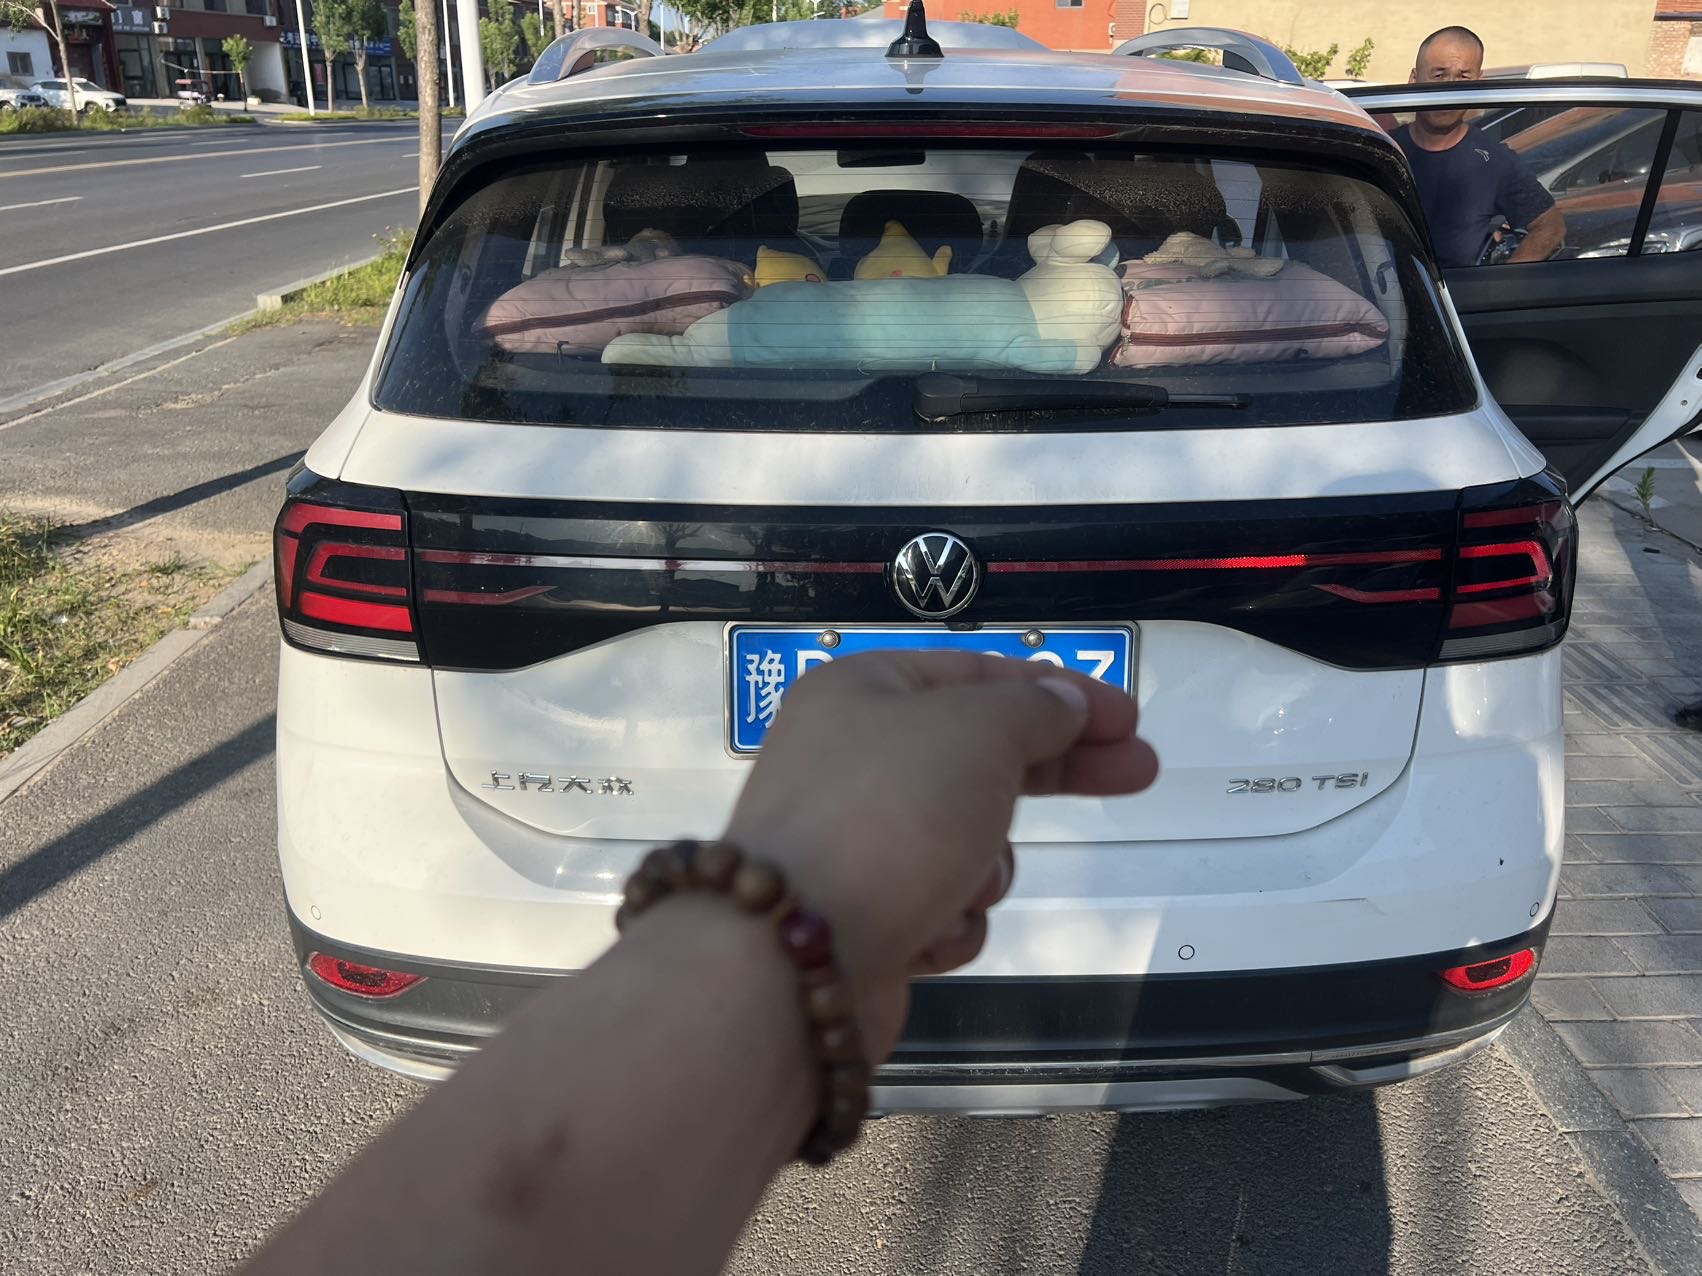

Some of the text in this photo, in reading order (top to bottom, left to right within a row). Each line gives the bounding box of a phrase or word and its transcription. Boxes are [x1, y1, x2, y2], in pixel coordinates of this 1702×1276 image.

[481, 770, 634, 796] 上汽大众
[1226, 772, 1369, 794] 280 TSI
